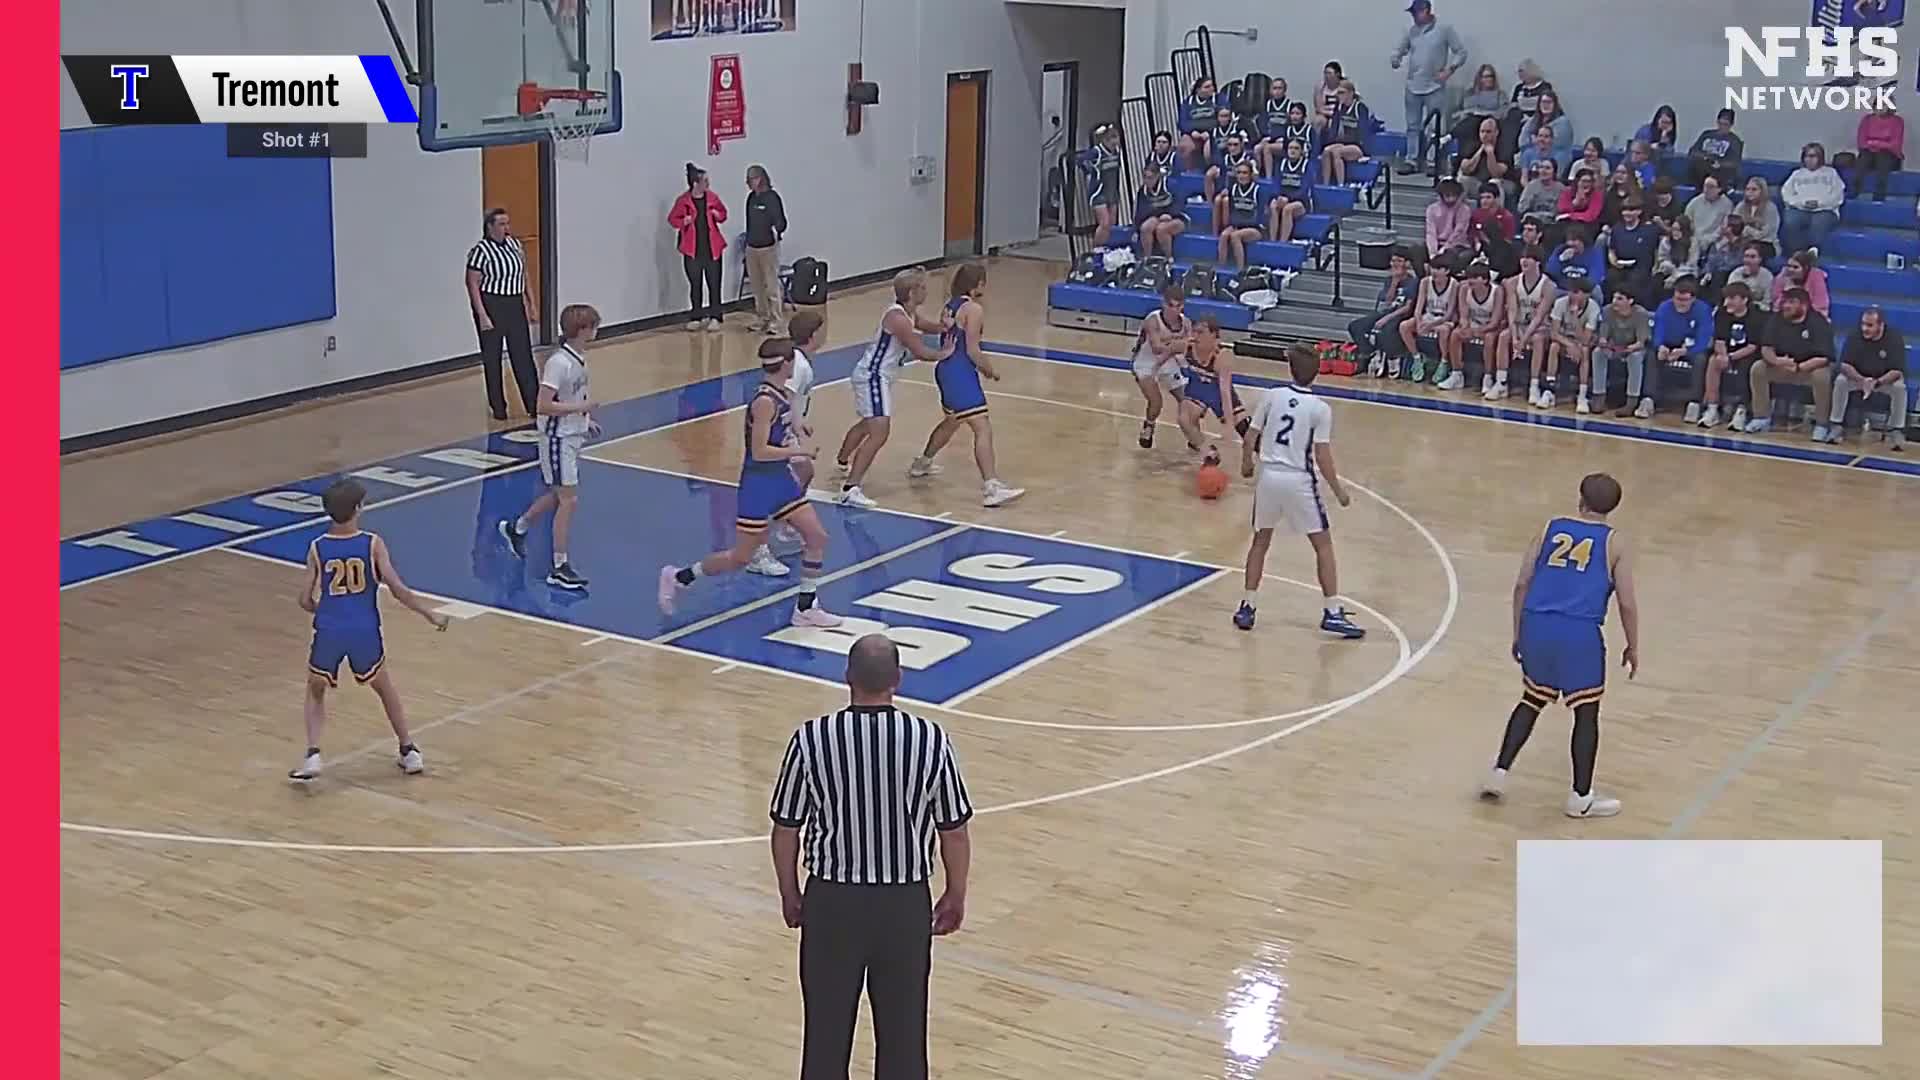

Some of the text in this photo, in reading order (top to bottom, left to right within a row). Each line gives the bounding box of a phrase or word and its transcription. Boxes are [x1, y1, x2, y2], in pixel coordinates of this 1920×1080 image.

[1275, 413, 1295, 446] 2
[1547, 532, 1594, 572] 24
[324, 557, 366, 596] 20
[762, 552, 1125, 671] BHS
